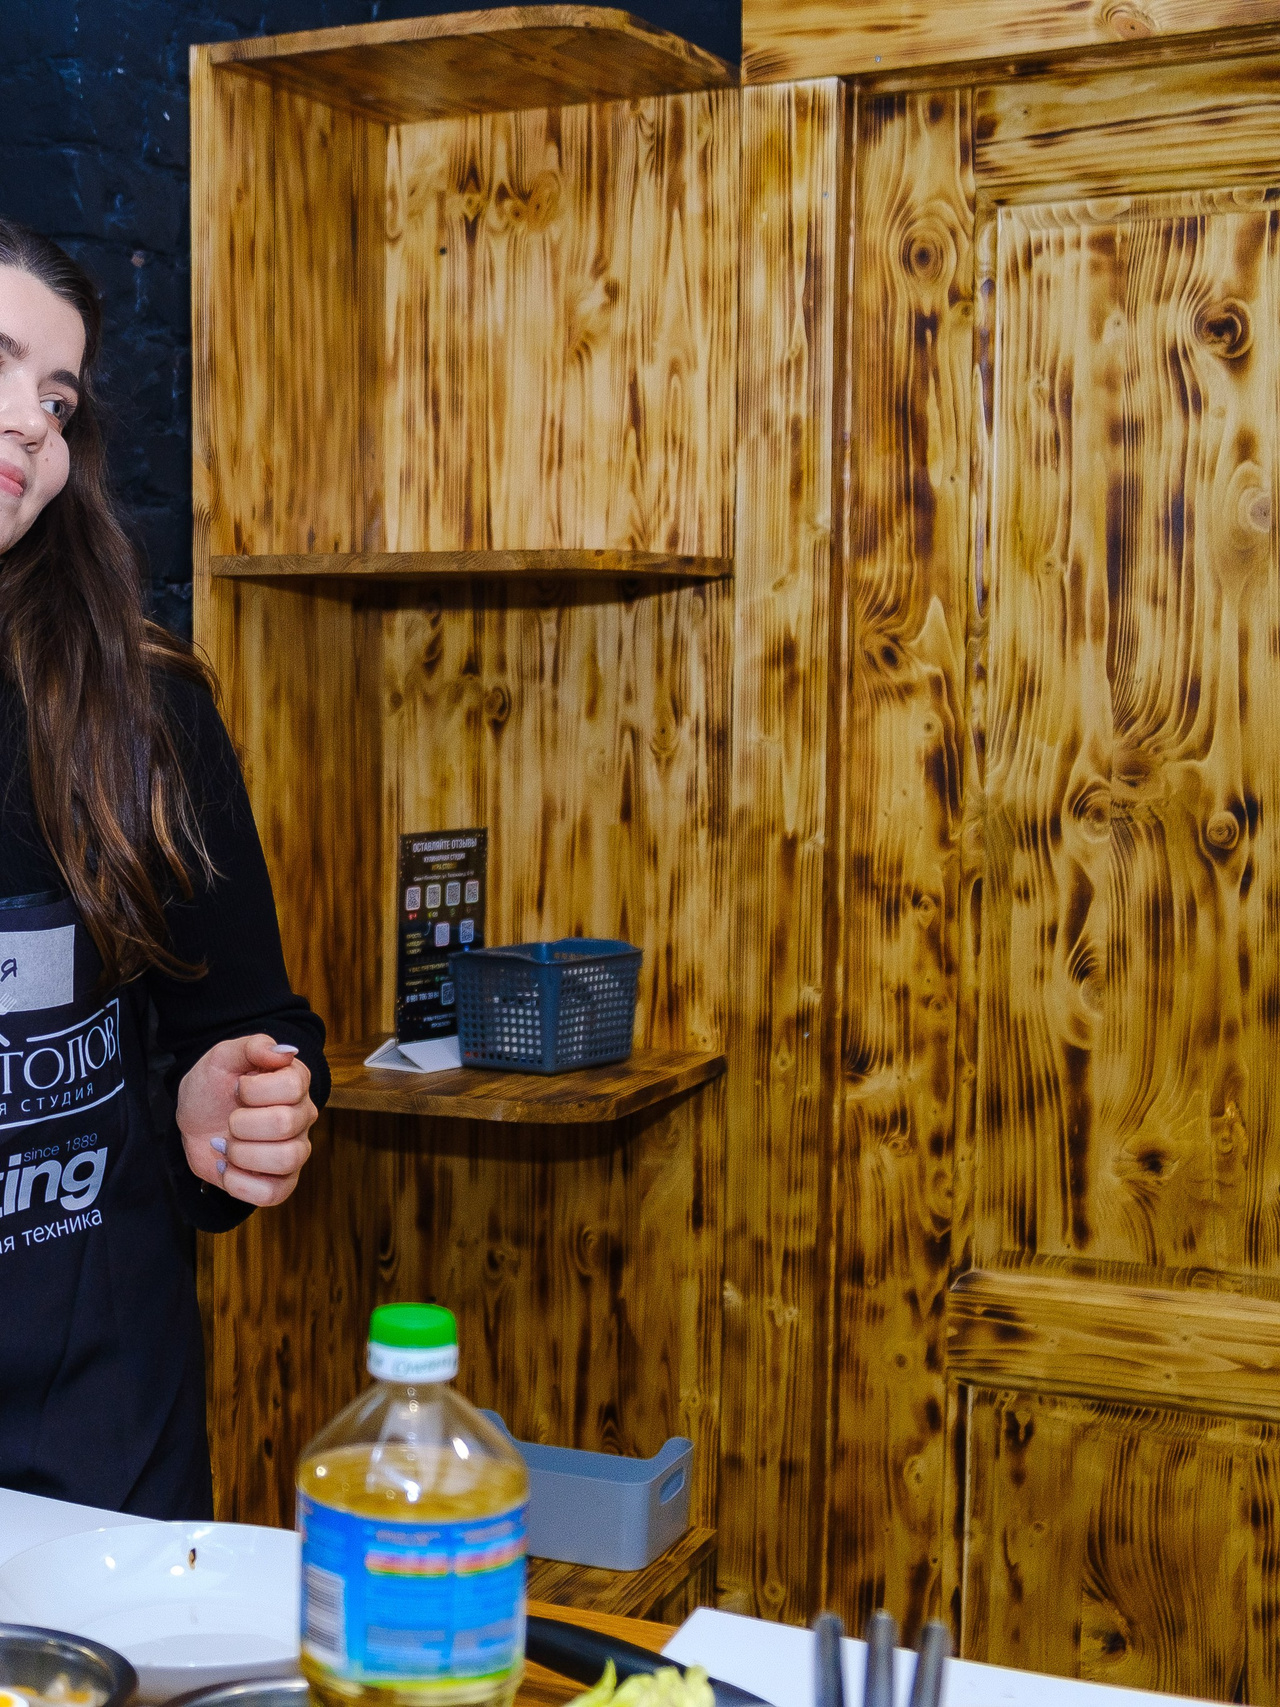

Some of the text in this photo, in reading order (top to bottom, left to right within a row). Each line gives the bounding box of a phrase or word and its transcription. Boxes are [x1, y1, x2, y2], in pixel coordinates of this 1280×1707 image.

[451, 837, 478, 850] ОТЗЫВЫ
[21, 1082, 95, 1113] СТУДИЯ
[23, 1132, 98, 1163] since 1889
[22, 1209, 103, 1247] техника
